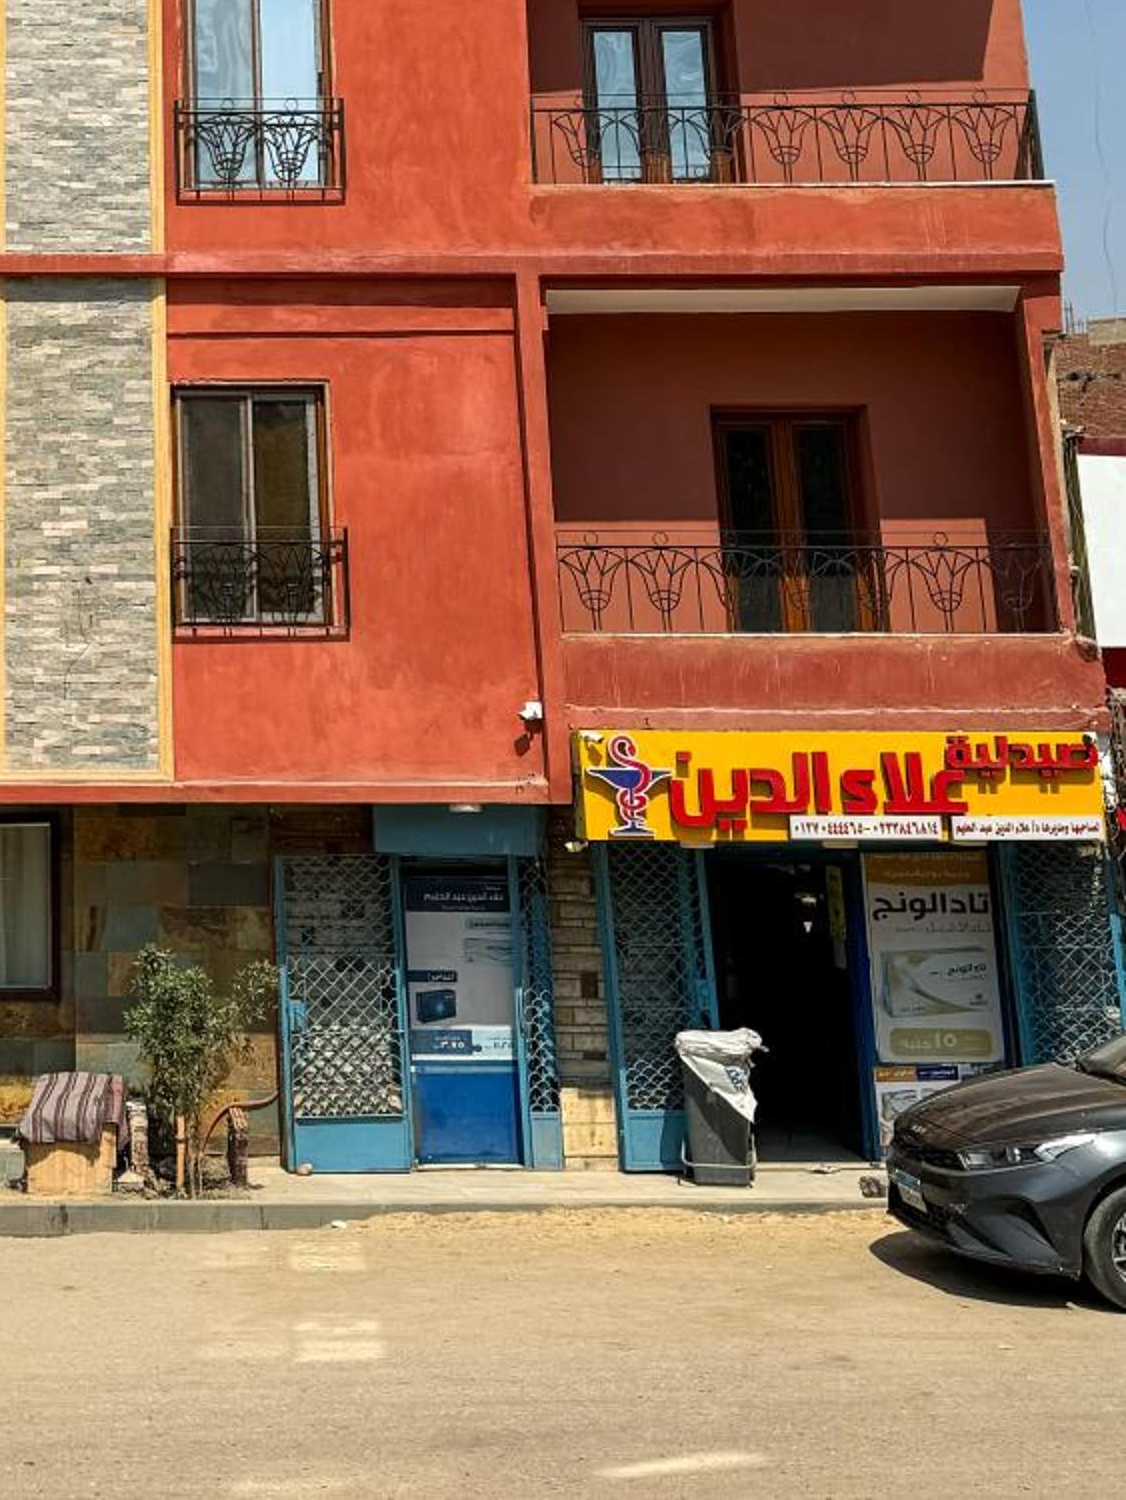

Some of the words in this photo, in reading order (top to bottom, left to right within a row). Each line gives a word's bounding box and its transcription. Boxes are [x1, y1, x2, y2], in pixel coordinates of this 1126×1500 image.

[842, 751, 969, 815] علاء
[945, 735, 1098, 778] صيدلية
[668, 751, 832, 831] الدين
[872, 891, 989, 920] تادالونج
